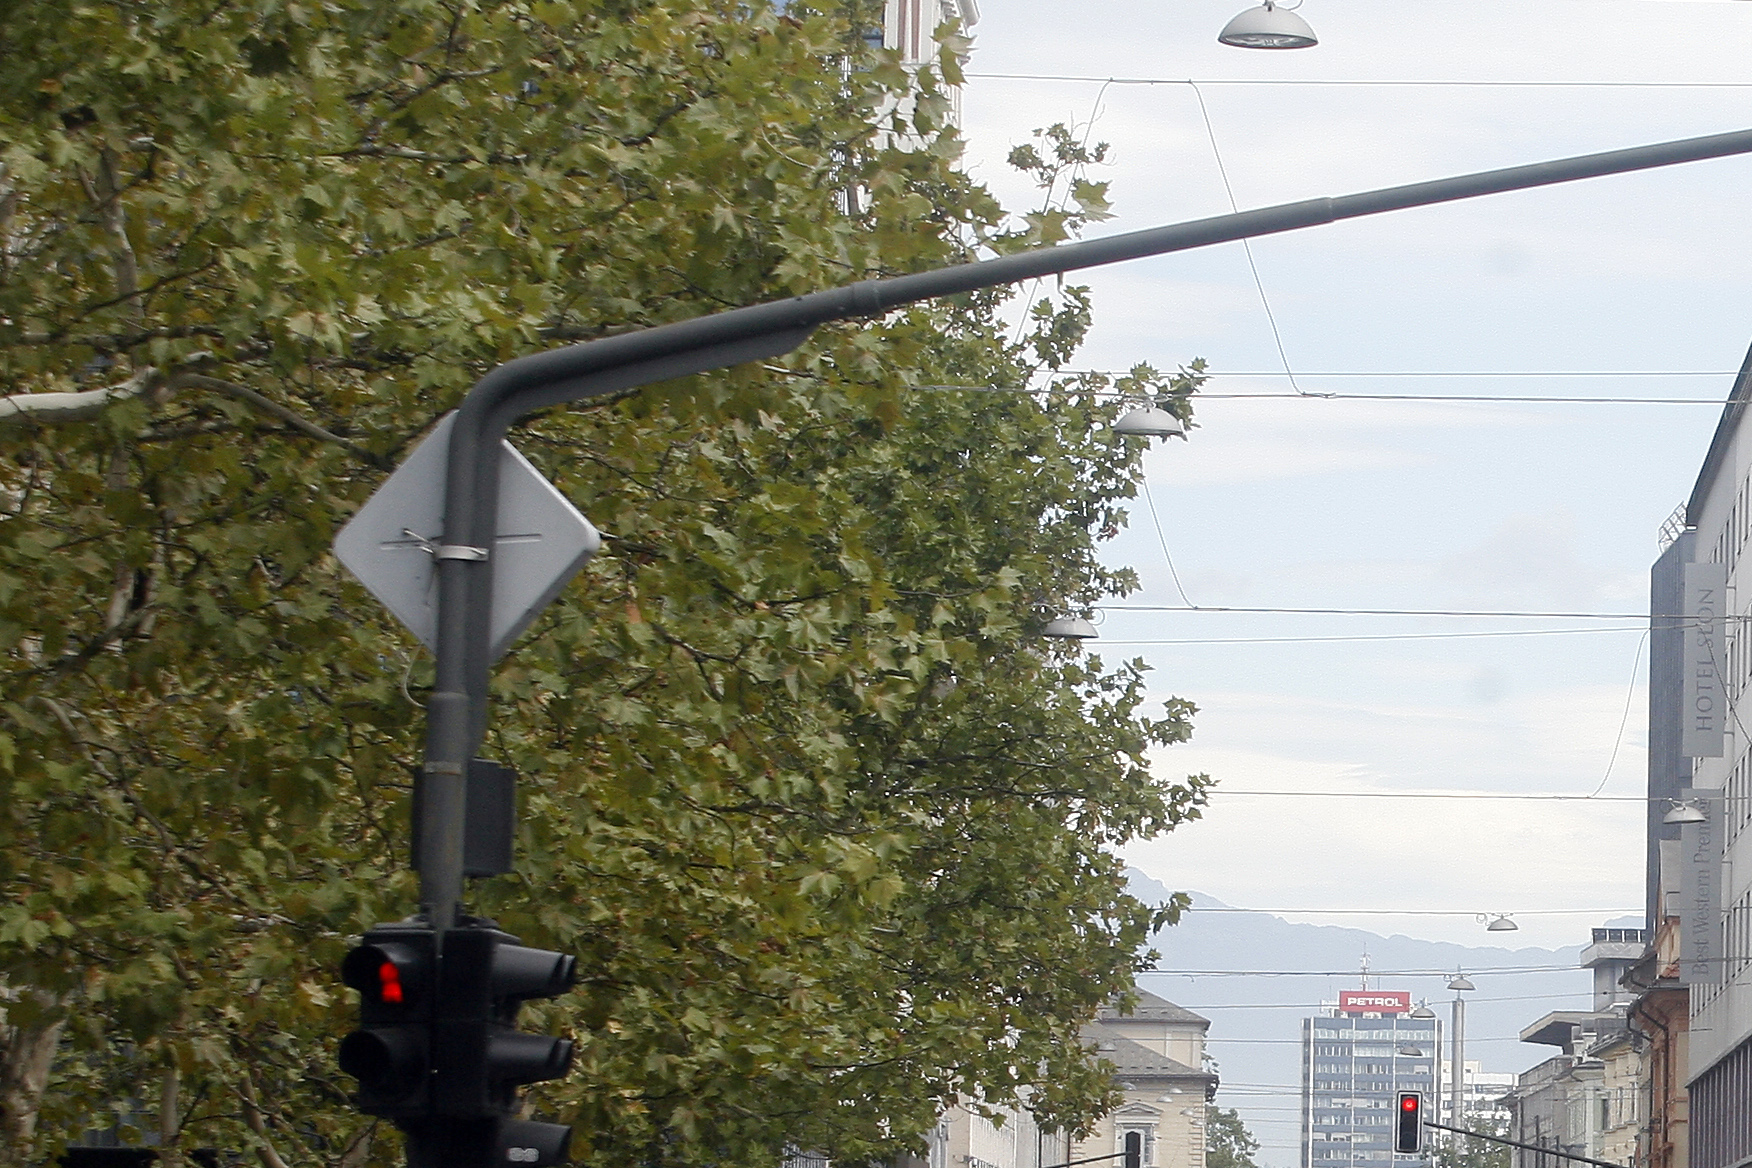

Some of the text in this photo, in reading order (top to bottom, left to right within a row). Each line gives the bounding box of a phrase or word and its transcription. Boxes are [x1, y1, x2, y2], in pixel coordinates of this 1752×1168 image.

[1696, 588, 1714, 732] HOTEL SLON
[1693, 870, 1710, 934] Western
[1692, 939, 1709, 976] Best
[1347, 997, 1403, 1007] PETROL
